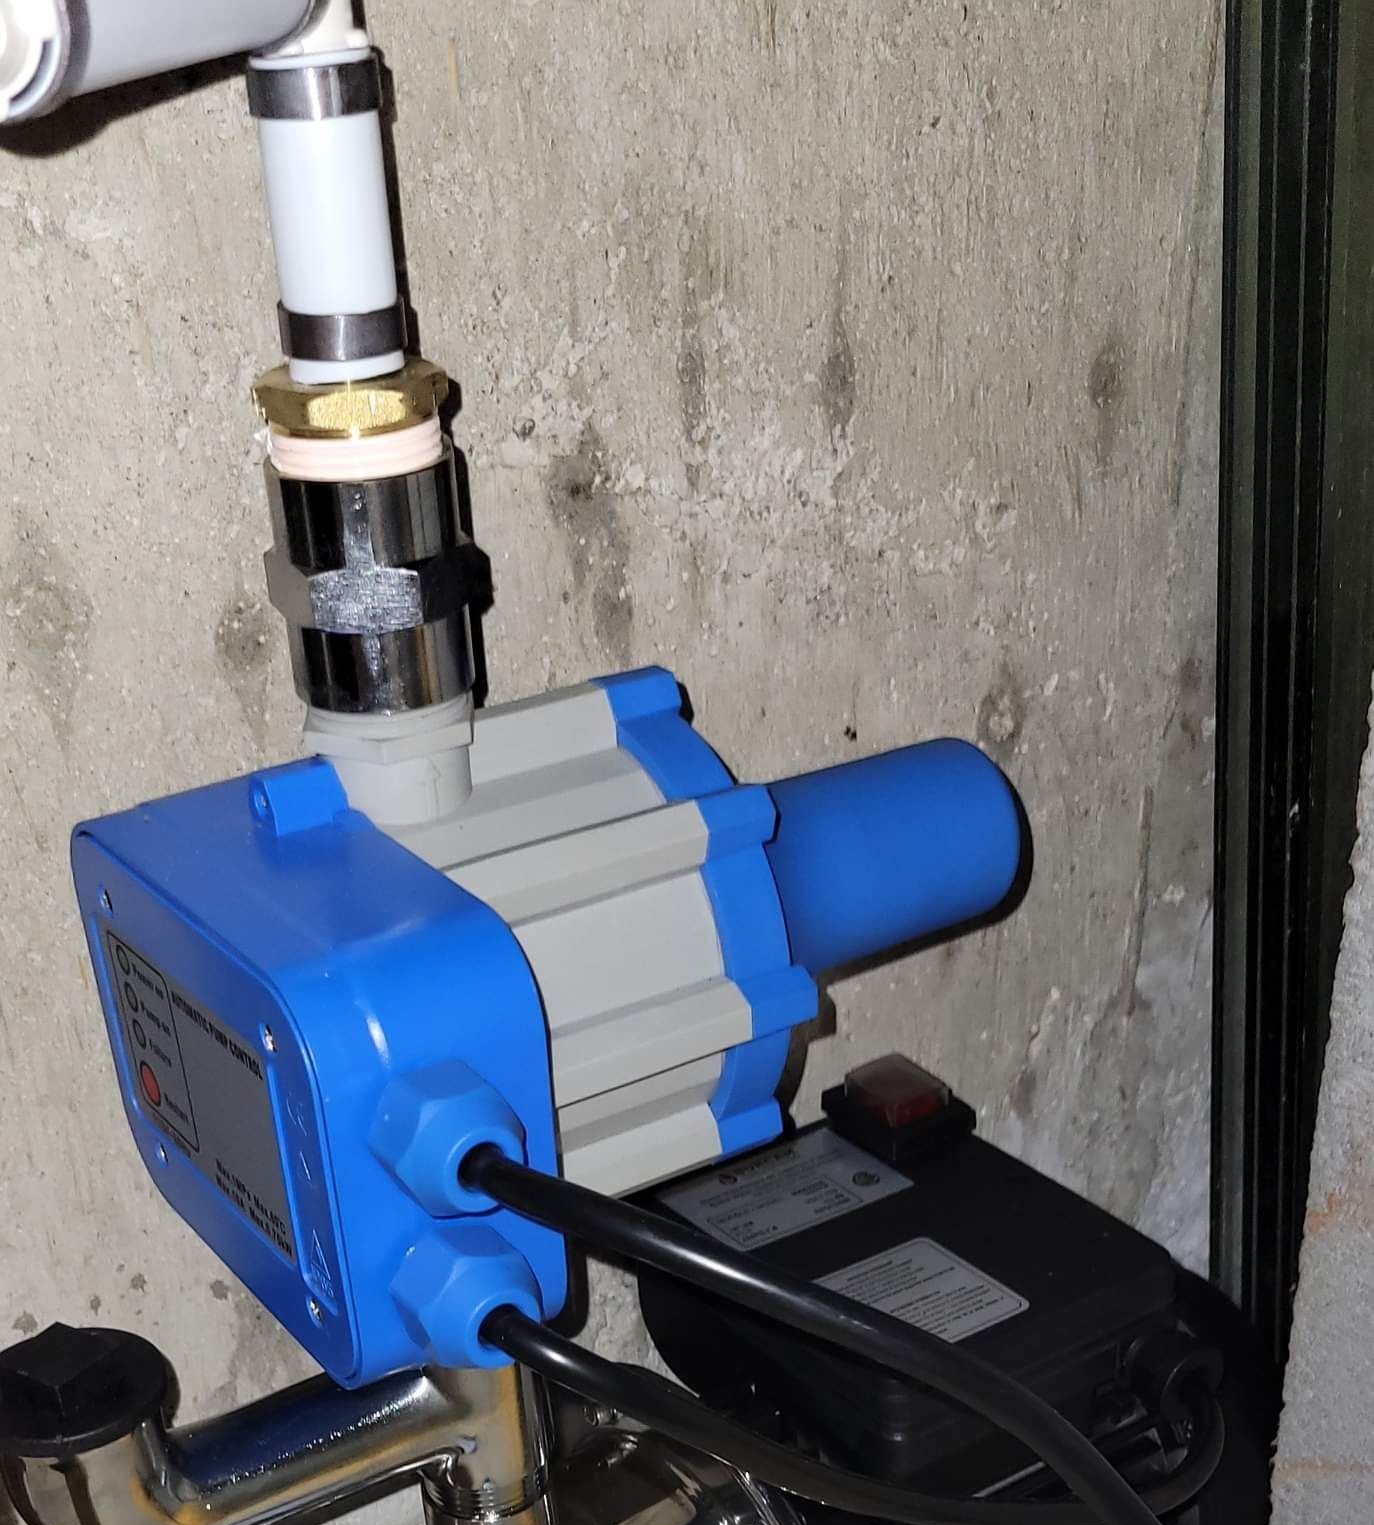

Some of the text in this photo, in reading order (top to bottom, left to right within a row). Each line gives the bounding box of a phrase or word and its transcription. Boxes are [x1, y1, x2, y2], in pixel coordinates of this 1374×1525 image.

[170, 989, 263, 1081] AUTOMATIC PUMP CONTROL
